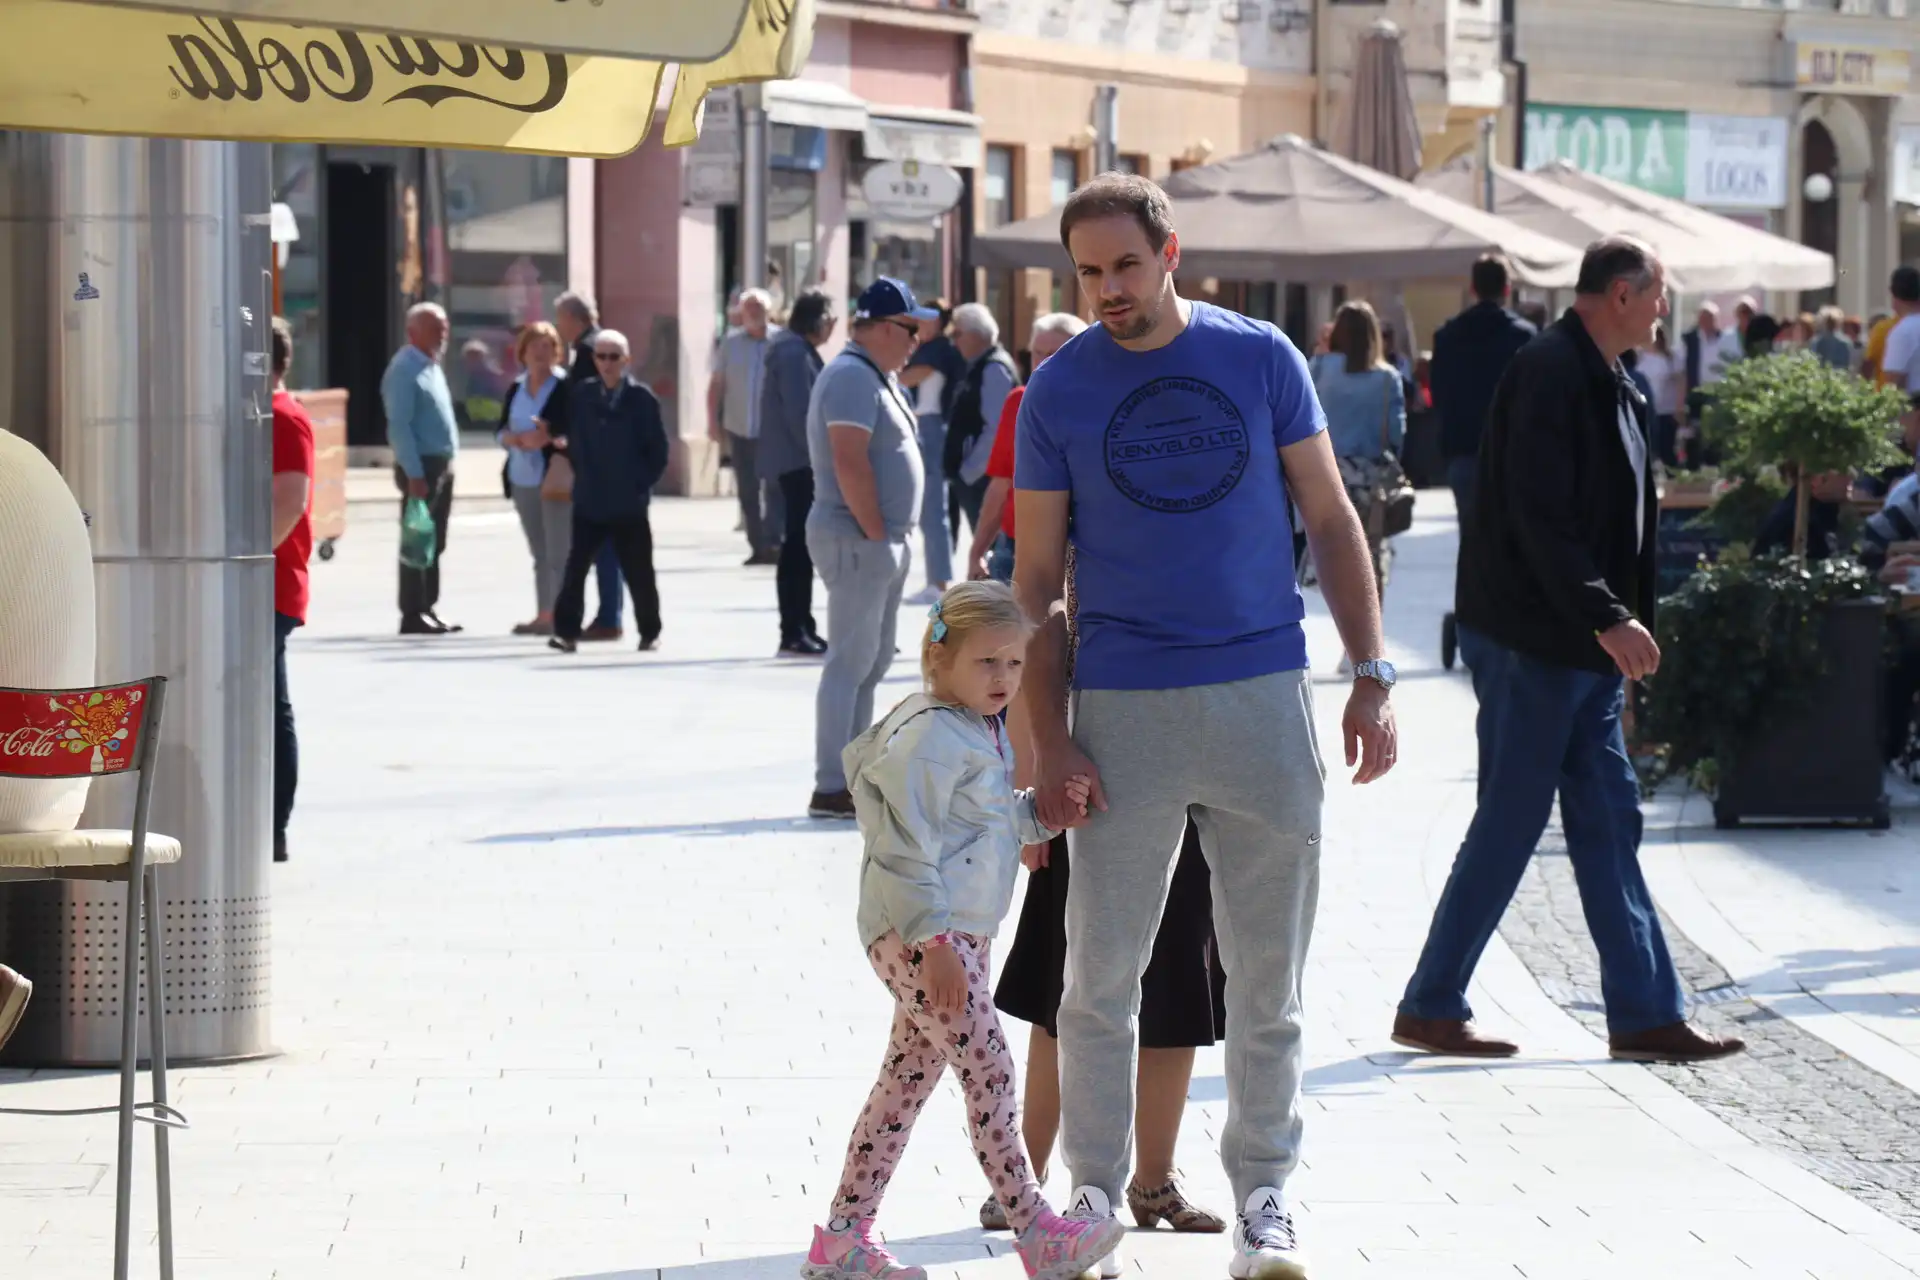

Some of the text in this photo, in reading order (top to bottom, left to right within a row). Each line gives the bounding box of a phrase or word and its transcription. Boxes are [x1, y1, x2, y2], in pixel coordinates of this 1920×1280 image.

[1841, 51, 1876, 84] CITY
[1524, 110, 1672, 184] MODA
[1163, 381, 1206, 397] URBAN
[1207, 391, 1239, 421] SPORT
[1111, 429, 1244, 460] KENVELO LTD
